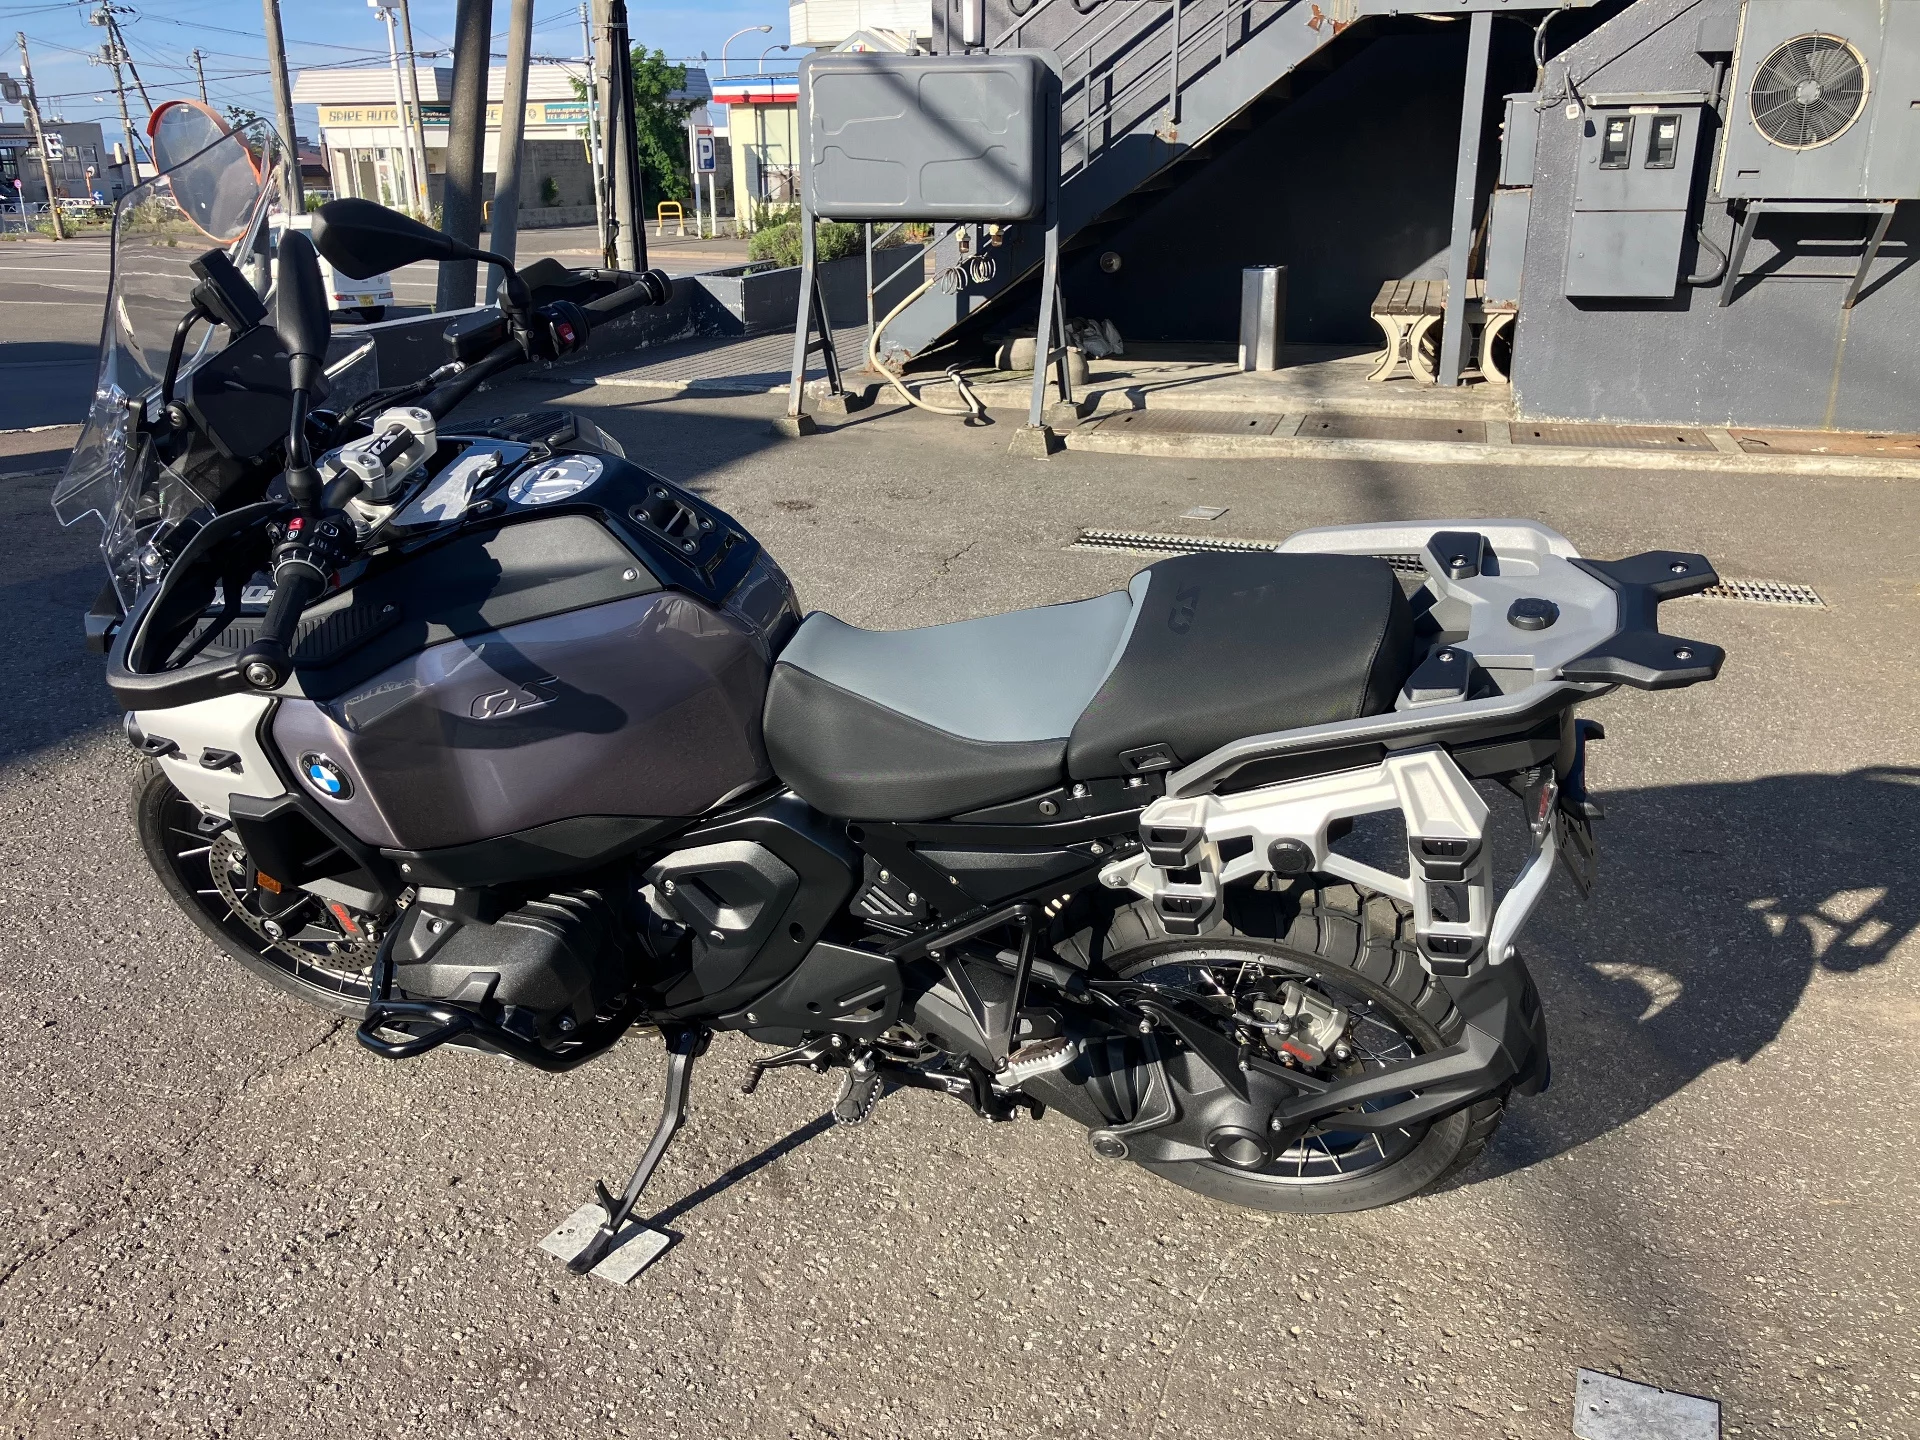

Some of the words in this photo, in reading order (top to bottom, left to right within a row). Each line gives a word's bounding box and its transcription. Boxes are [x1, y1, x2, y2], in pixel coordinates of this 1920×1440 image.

[329, 111, 362, 122] SPIRE
[366, 109, 399, 121] AUTO
[699, 139, 713, 169] P
[303, 756, 339, 774] BMW
[331, 903, 358, 933] BMW
